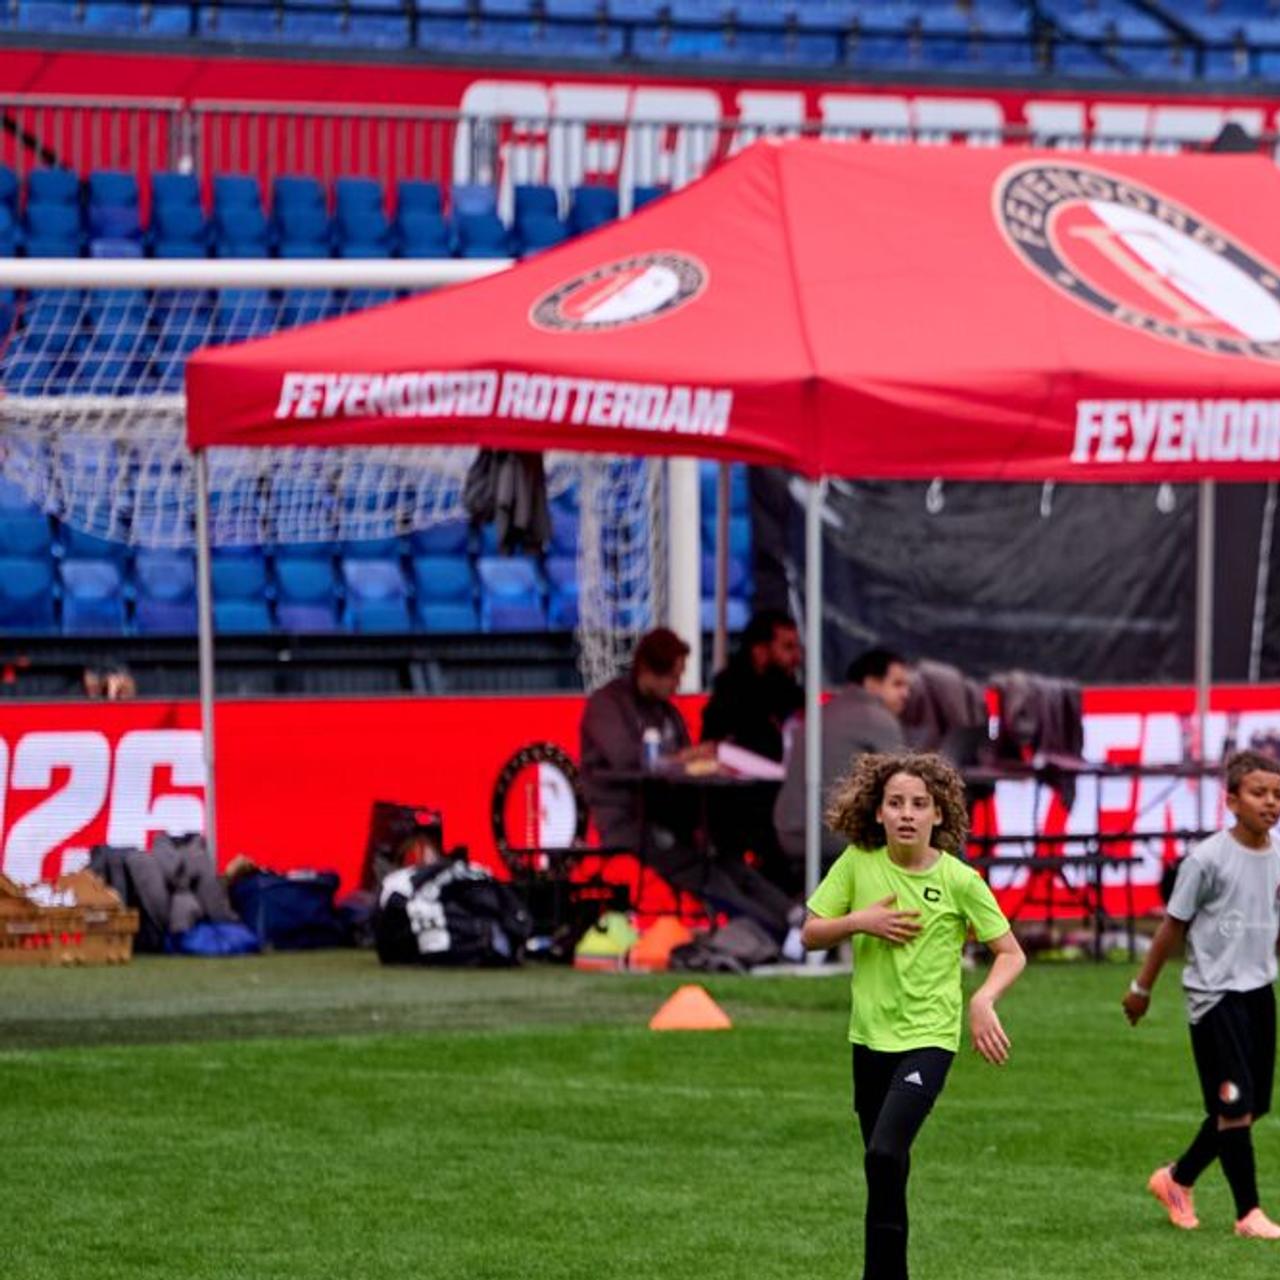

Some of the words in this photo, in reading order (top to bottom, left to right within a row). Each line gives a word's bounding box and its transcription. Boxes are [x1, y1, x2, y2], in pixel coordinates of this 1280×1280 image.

[275, 369, 499, 419] FEYENOORD
[498, 371, 734, 436] ROTTERDAM
[0, 730, 206, 889] 26
